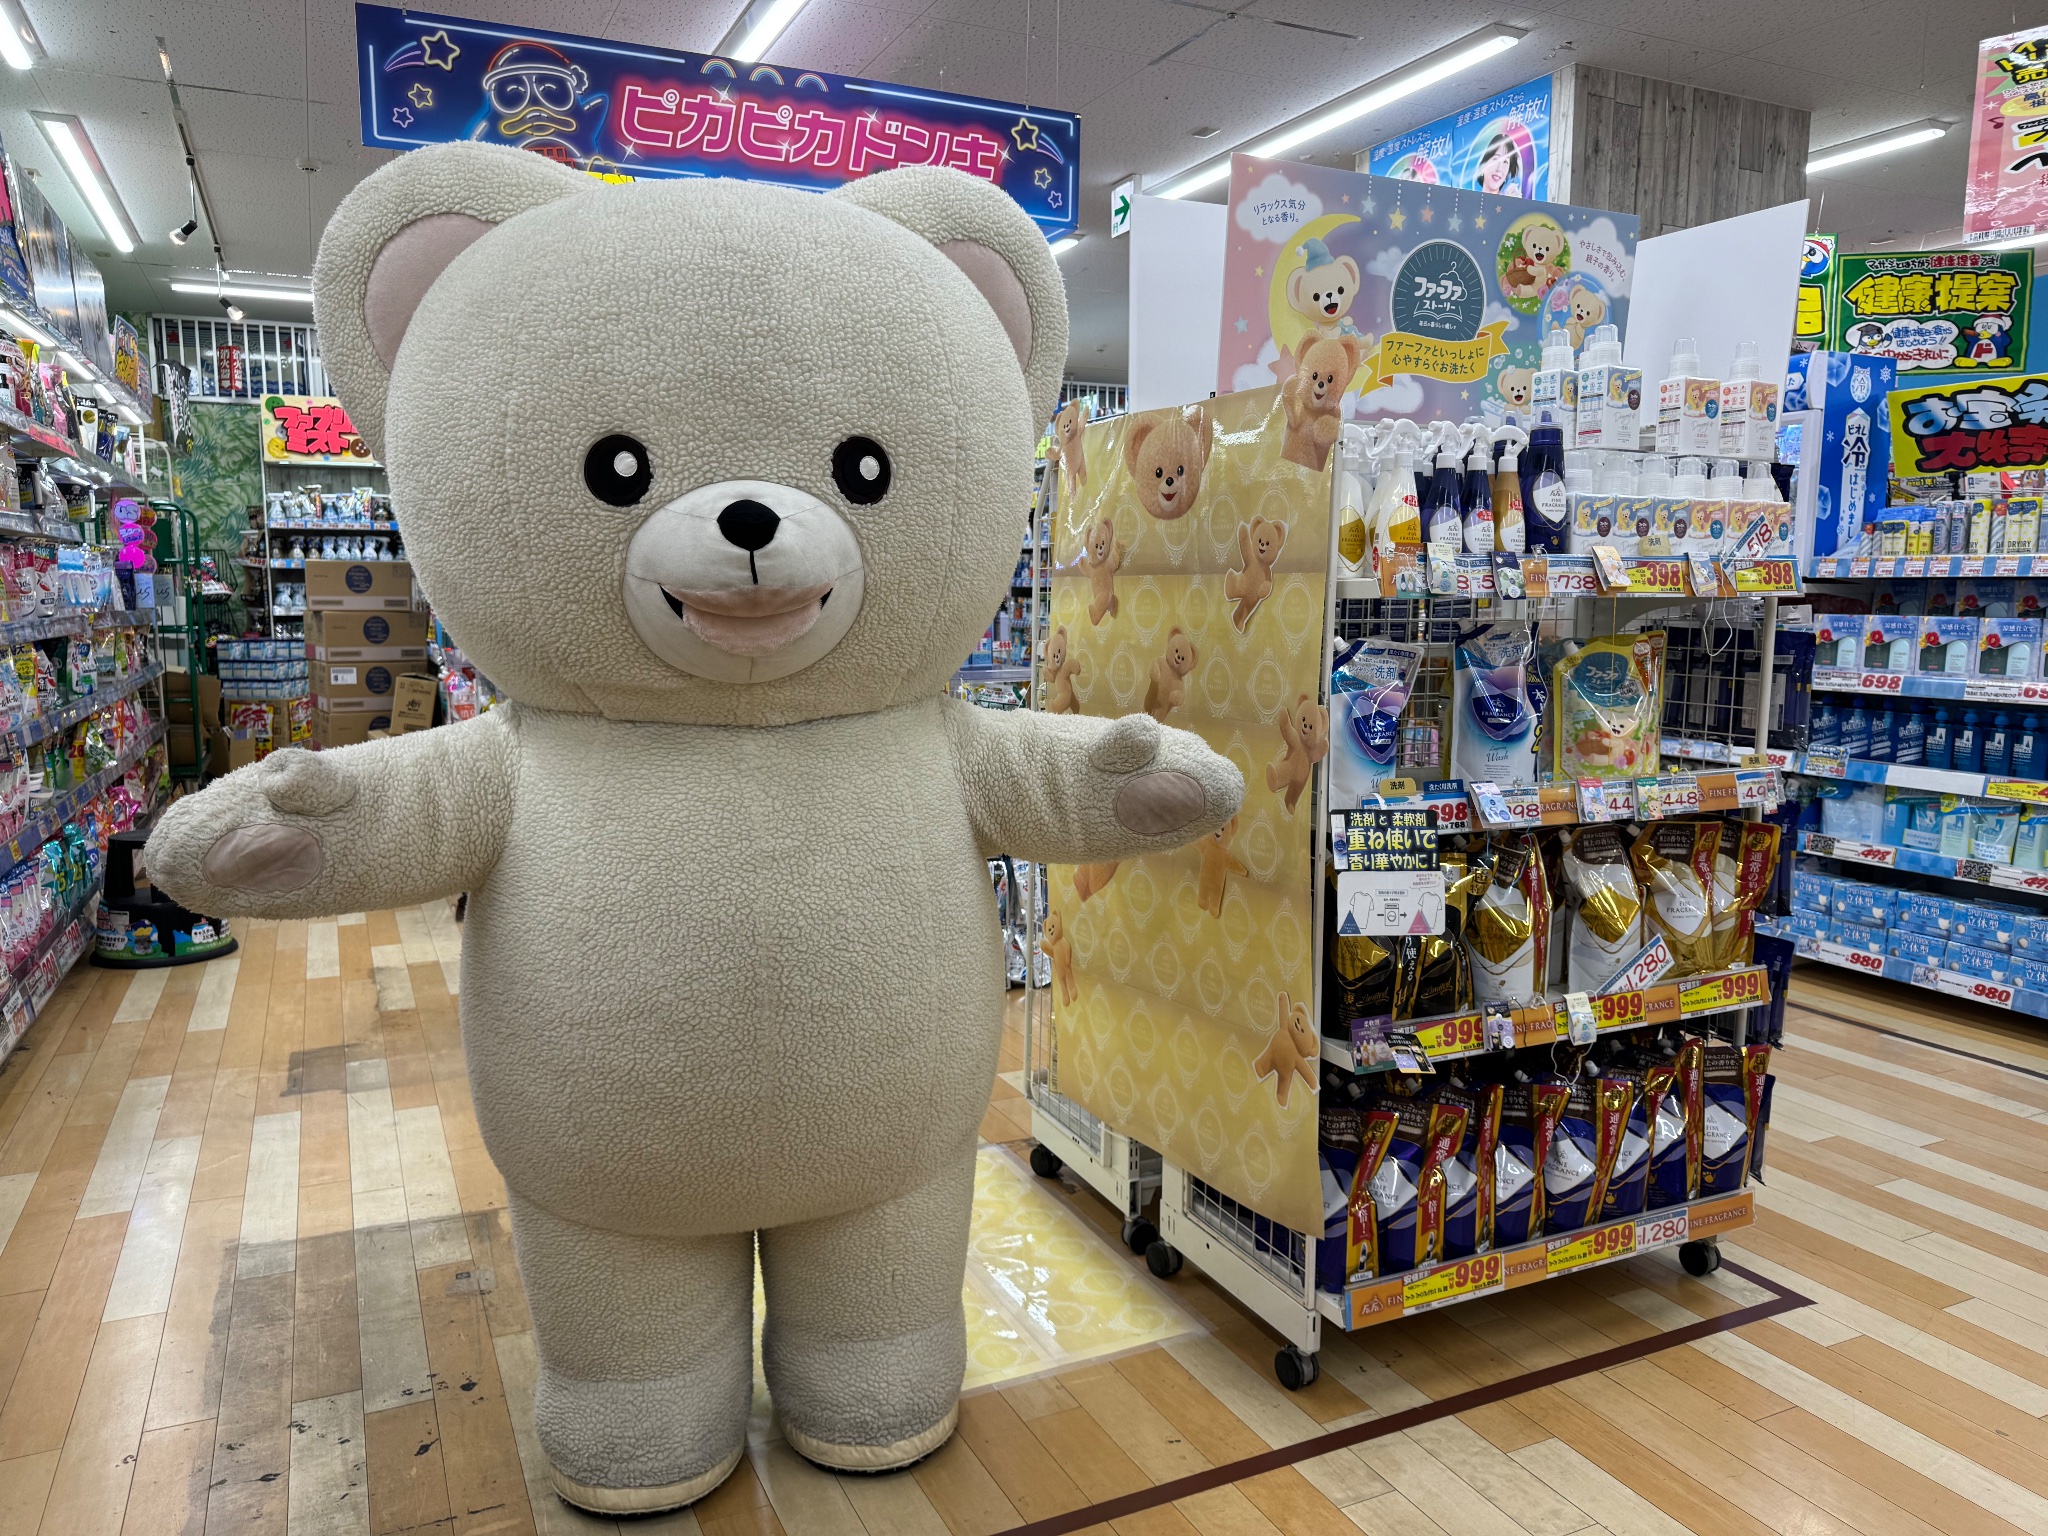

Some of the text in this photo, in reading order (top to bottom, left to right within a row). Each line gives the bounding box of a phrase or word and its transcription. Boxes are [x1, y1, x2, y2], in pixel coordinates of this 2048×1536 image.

[1507, 94, 1548, 130] 解放!
[621, 85, 999, 181] ピカピカドンキ
[1253, 199, 1306, 215] リラックス気分
[1262, 212, 1299, 225] となる香り。
[1580, 240, 1626, 282] やさしさで包み込む、
[1586, 254, 1615, 281] 親子の香り。
[1414, 276, 1462, 300] ファーファ
[1844, 271, 2019, 316] 健康提案
[1423, 300, 1456, 310] ストーリー
[1386, 341, 1485, 360] ファーファといっしょに
[1973, 343, 1993, 358] ド
[220, 349, 230, 379] 消火器
[1392, 355, 1475, 374] 心やすらぐお洗たく
[286, 428, 349, 454] ミスト
[1848, 424, 1866, 435] ビオレ
[1843, 436, 1870, 468] 冷
[1647, 562, 1681, 586] 398
[1762, 562, 1793, 585] 398
[1862, 674, 1902, 689] 698
[1486, 751, 1509, 762] Wash
[1390, 780, 1405, 790] 洗剤
[1709, 788, 1727, 797] FINE
[1347, 827, 1436, 851] 重ね使いで
[1349, 853, 1437, 871] 香り華やかに!
[1860, 848, 1892, 861] 498
[1849, 952, 1883, 970] 980
[1722, 973, 1759, 1000] 999
[1973, 983, 2011, 1003] 980
[1602, 993, 1643, 1020] 999
[1443, 1019, 1483, 1048] 999
[1705, 1208, 1747, 1226] FRAGRANCE
[1594, 1224, 1634, 1254] 999
[1641, 1217, 1687, 1245] 1,280
[1455, 1255, 1499, 1288] 999
